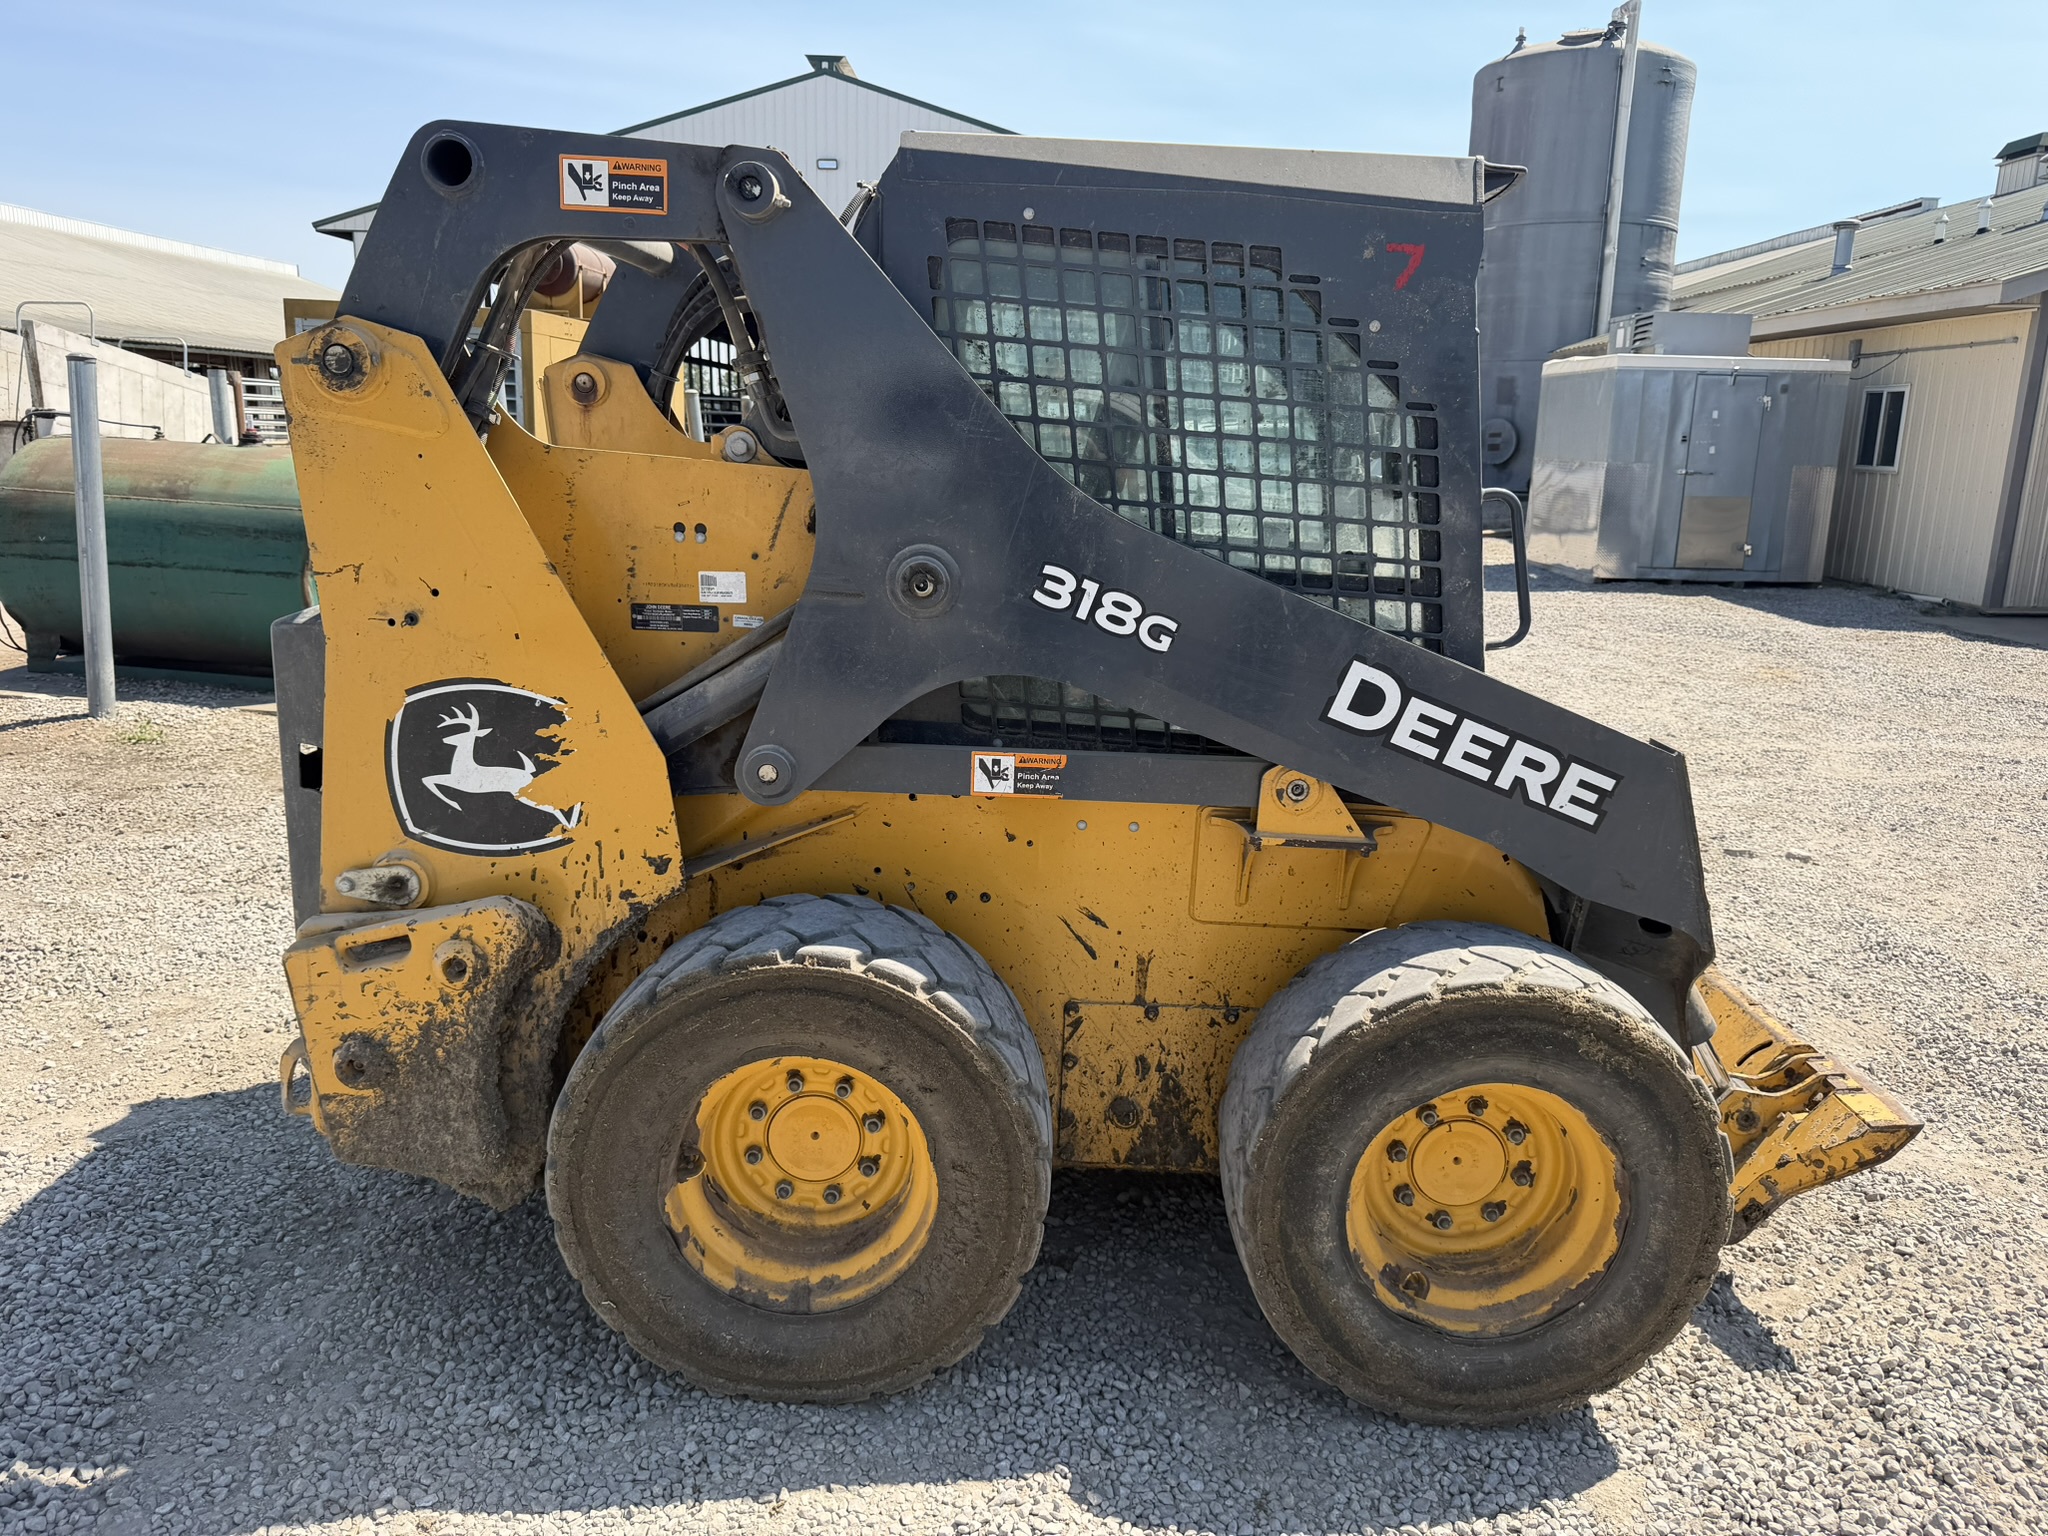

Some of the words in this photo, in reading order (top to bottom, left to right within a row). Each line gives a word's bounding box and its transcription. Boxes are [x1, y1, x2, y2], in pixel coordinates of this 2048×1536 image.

[621, 163, 662, 172] WARNING
[612, 181, 638, 190] Pinch
[639, 183, 660, 192] Area
[612, 193, 632, 202] Keep
[633, 194, 654, 203] Away
[1386, 243, 1426, 291] 7
[1032, 564, 1178, 652] 318G
[1327, 660, 1617, 826] DEERE
